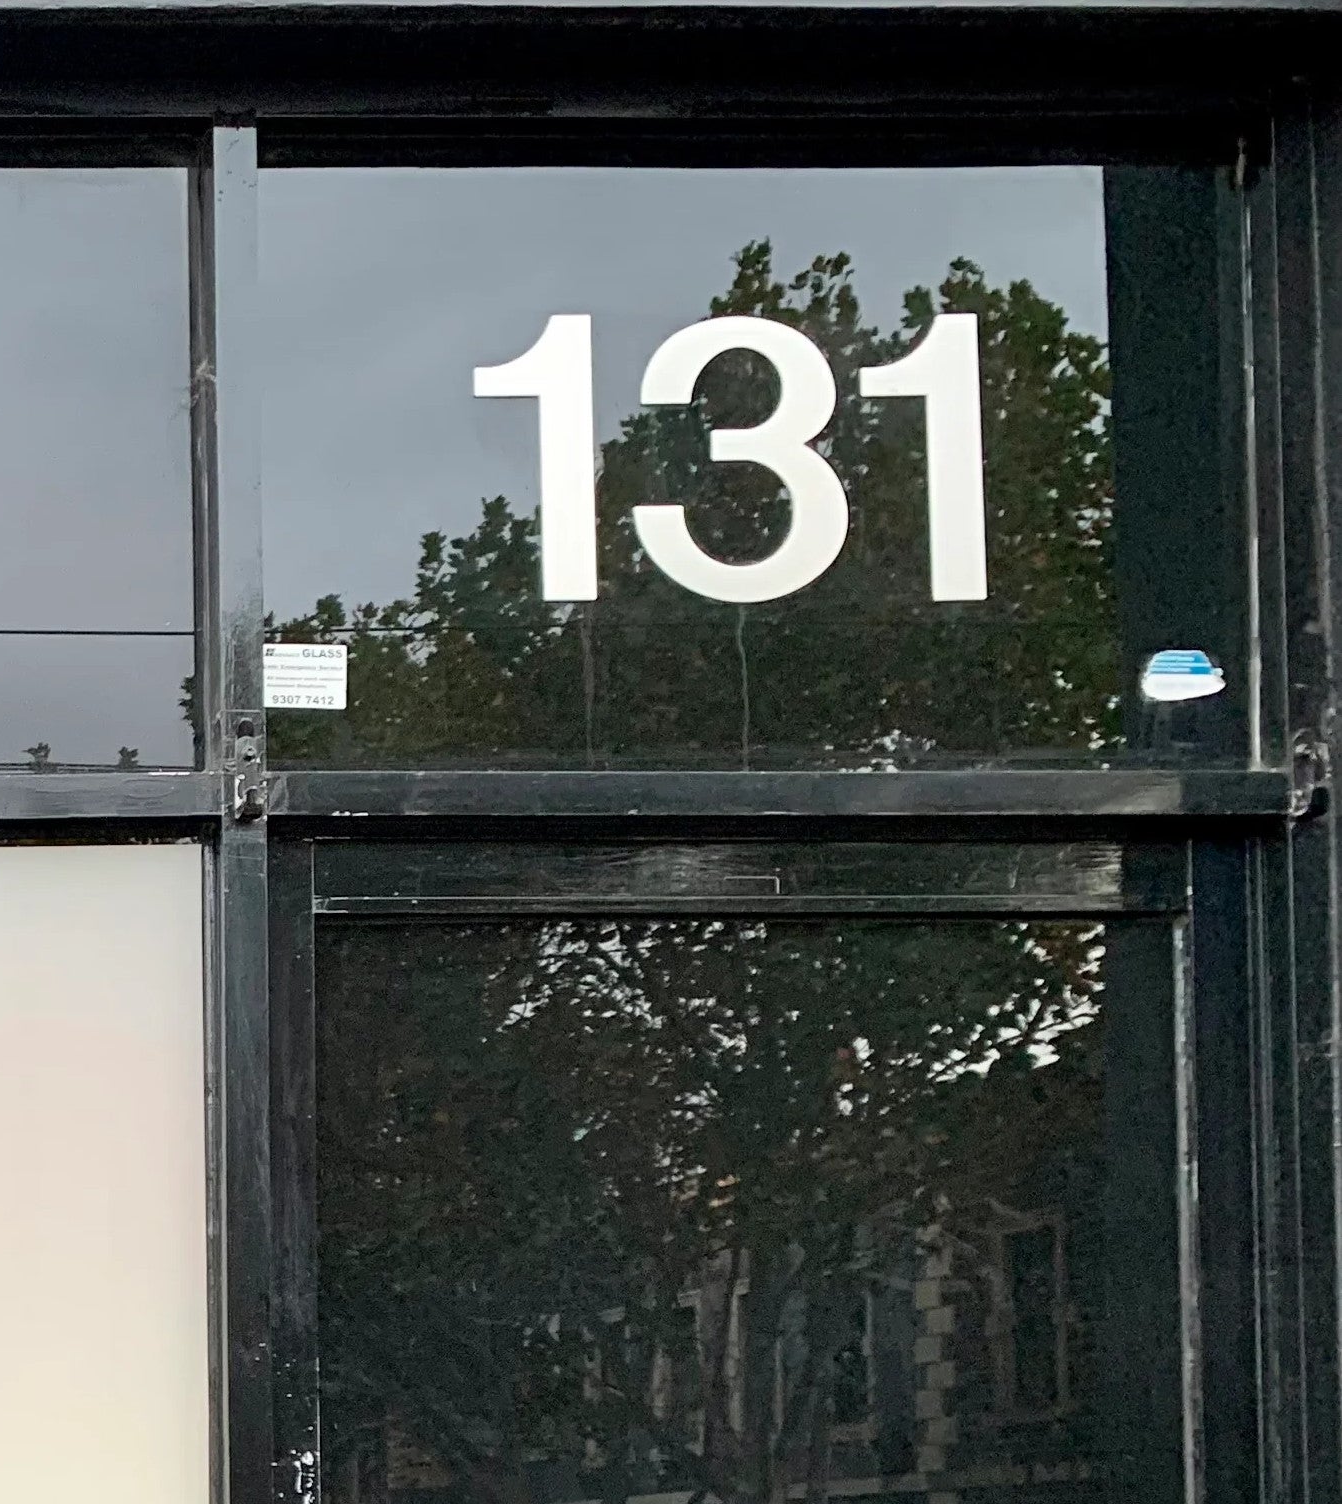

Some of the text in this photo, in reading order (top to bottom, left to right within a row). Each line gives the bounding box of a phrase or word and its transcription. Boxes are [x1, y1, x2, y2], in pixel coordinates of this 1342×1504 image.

[473, 313, 988, 603] 131
[302, 648, 343, 658] GLASS
[272, 695, 334, 705] 9307 7412
